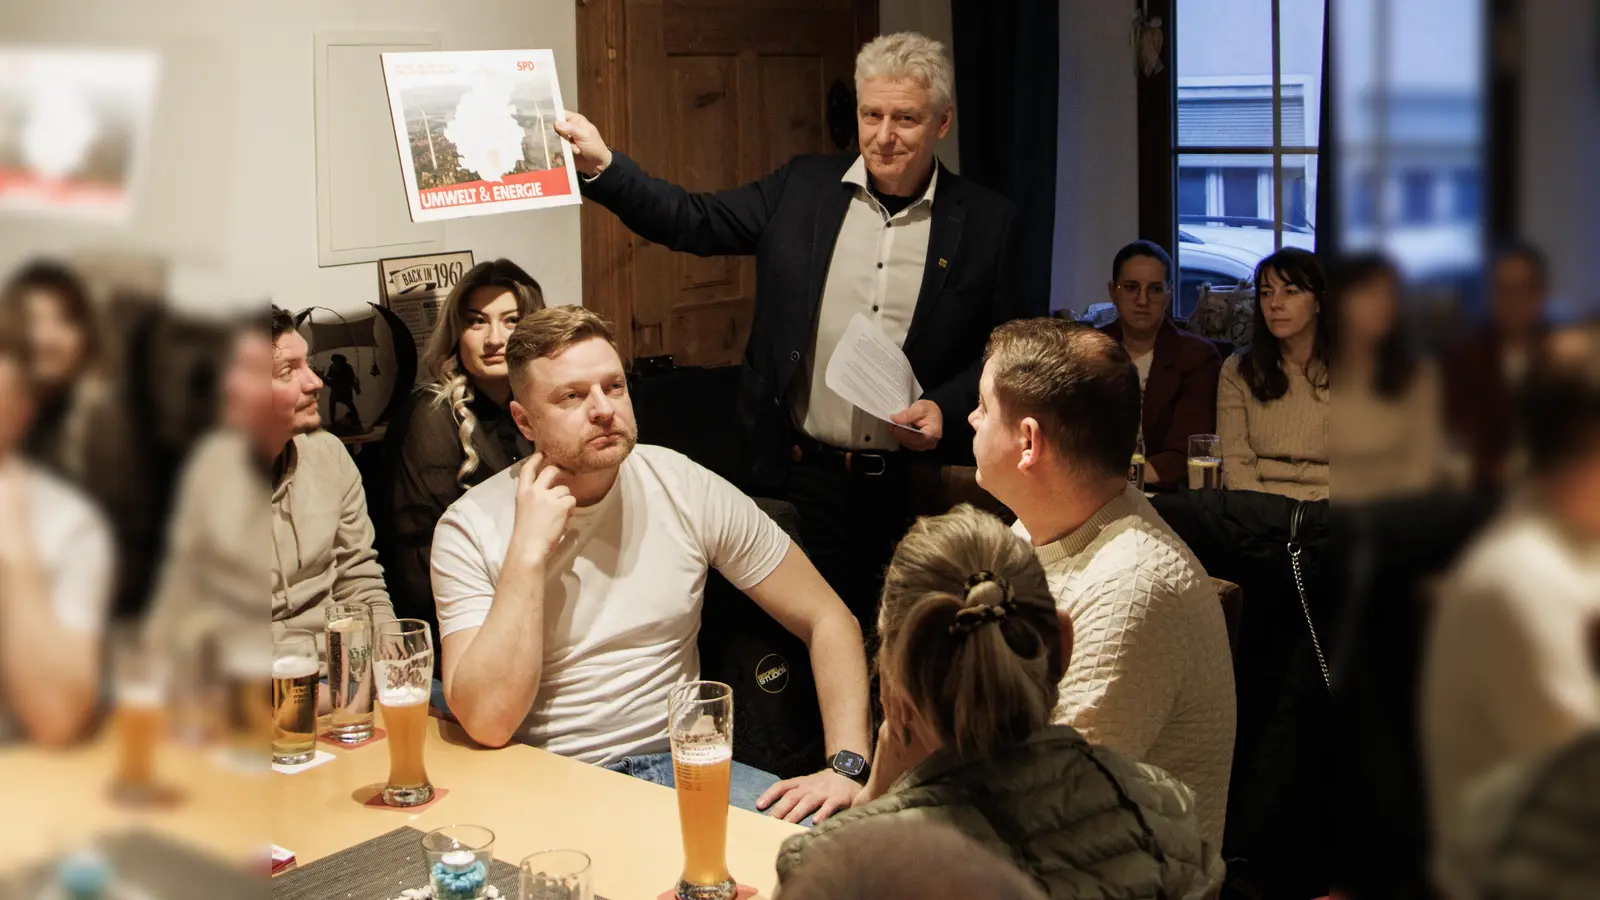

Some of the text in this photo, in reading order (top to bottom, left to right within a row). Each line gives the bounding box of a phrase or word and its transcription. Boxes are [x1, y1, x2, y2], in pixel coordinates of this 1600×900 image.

[516, 60, 535, 71] SPD
[420, 181, 543, 208] UMWELT & ENERGIE
[401, 267, 423, 286] BACK
[423, 267, 433, 281] IN
